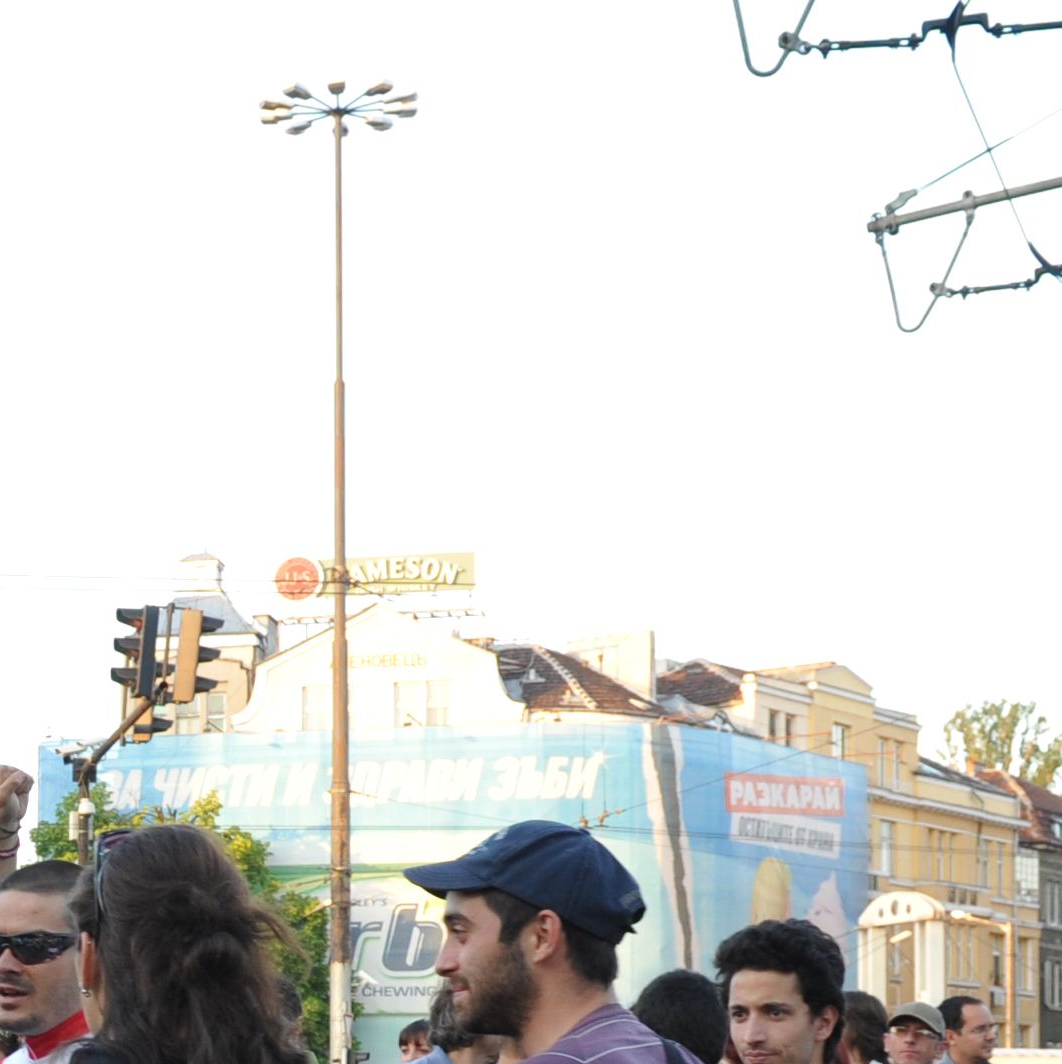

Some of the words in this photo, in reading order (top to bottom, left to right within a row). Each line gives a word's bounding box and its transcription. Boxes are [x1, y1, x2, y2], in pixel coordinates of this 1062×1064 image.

[348, 556, 461, 584] AMESON
[282, 763, 319, 806] И
[362, 985, 436, 998] CHEWING
